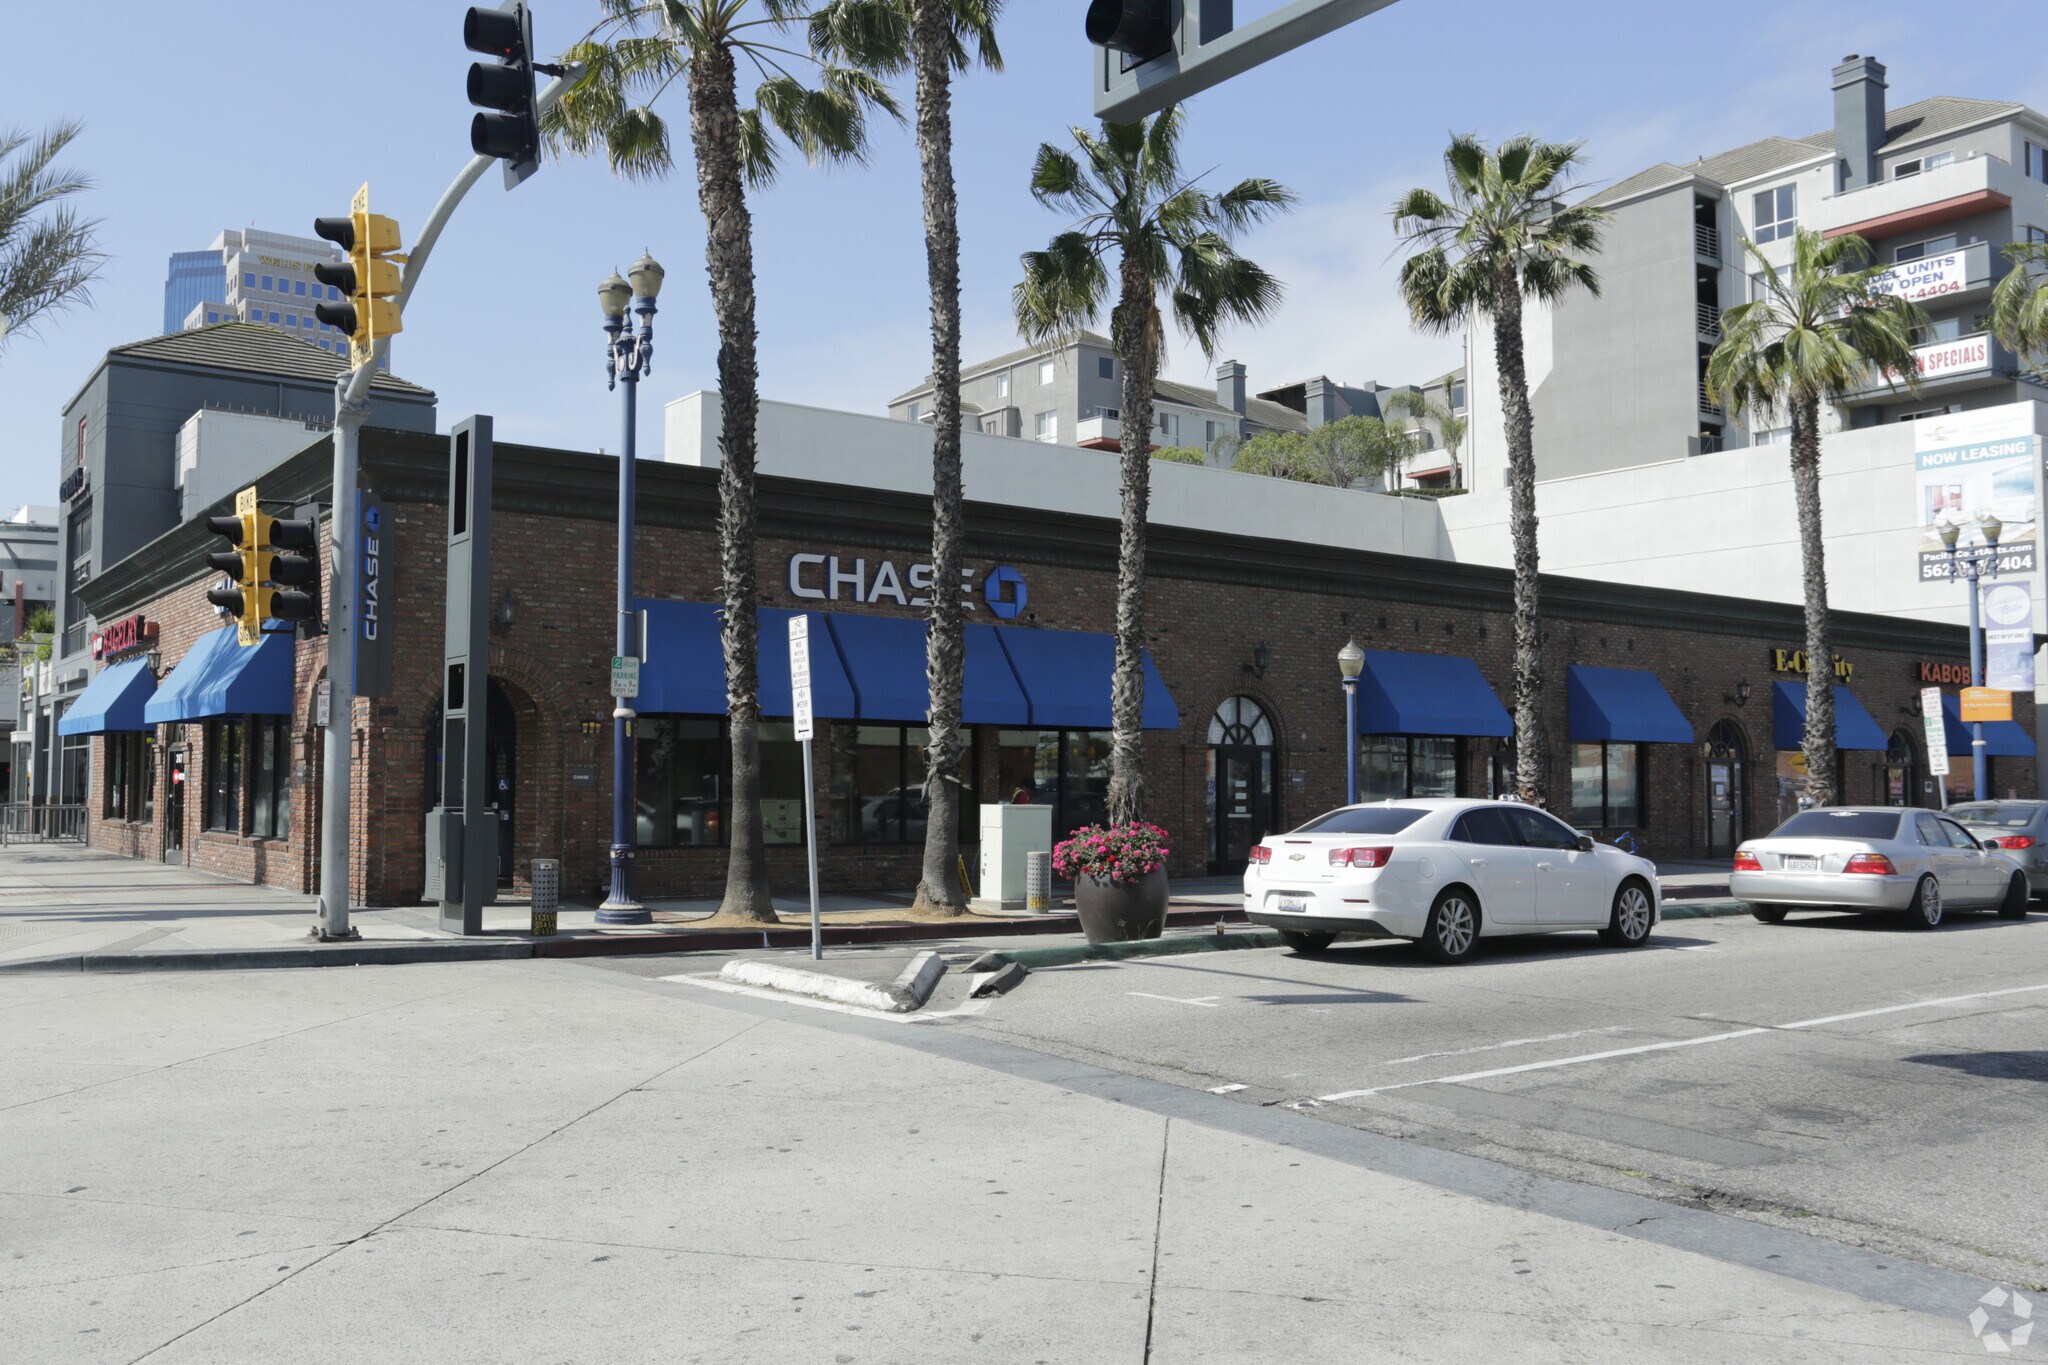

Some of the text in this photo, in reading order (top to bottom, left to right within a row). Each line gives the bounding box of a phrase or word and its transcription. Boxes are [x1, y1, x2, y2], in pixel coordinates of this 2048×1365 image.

[258, 255, 301, 270] WELLS
[1907, 256, 1956, 275] UNITS
[1900, 271, 1944, 290] OPEN
[1928, 344, 1985, 371] SPECIALS
[1922, 441, 2027, 467] NOW LEASING
[240, 491, 254, 512] BIKE
[364, 536, 380, 641] CHASE
[103, 614, 139, 656] BAGELRY
[239, 624, 260, 643] SIGNAL
[614, 658, 621, 668] 2
[613, 672, 638, 680] PARKING
